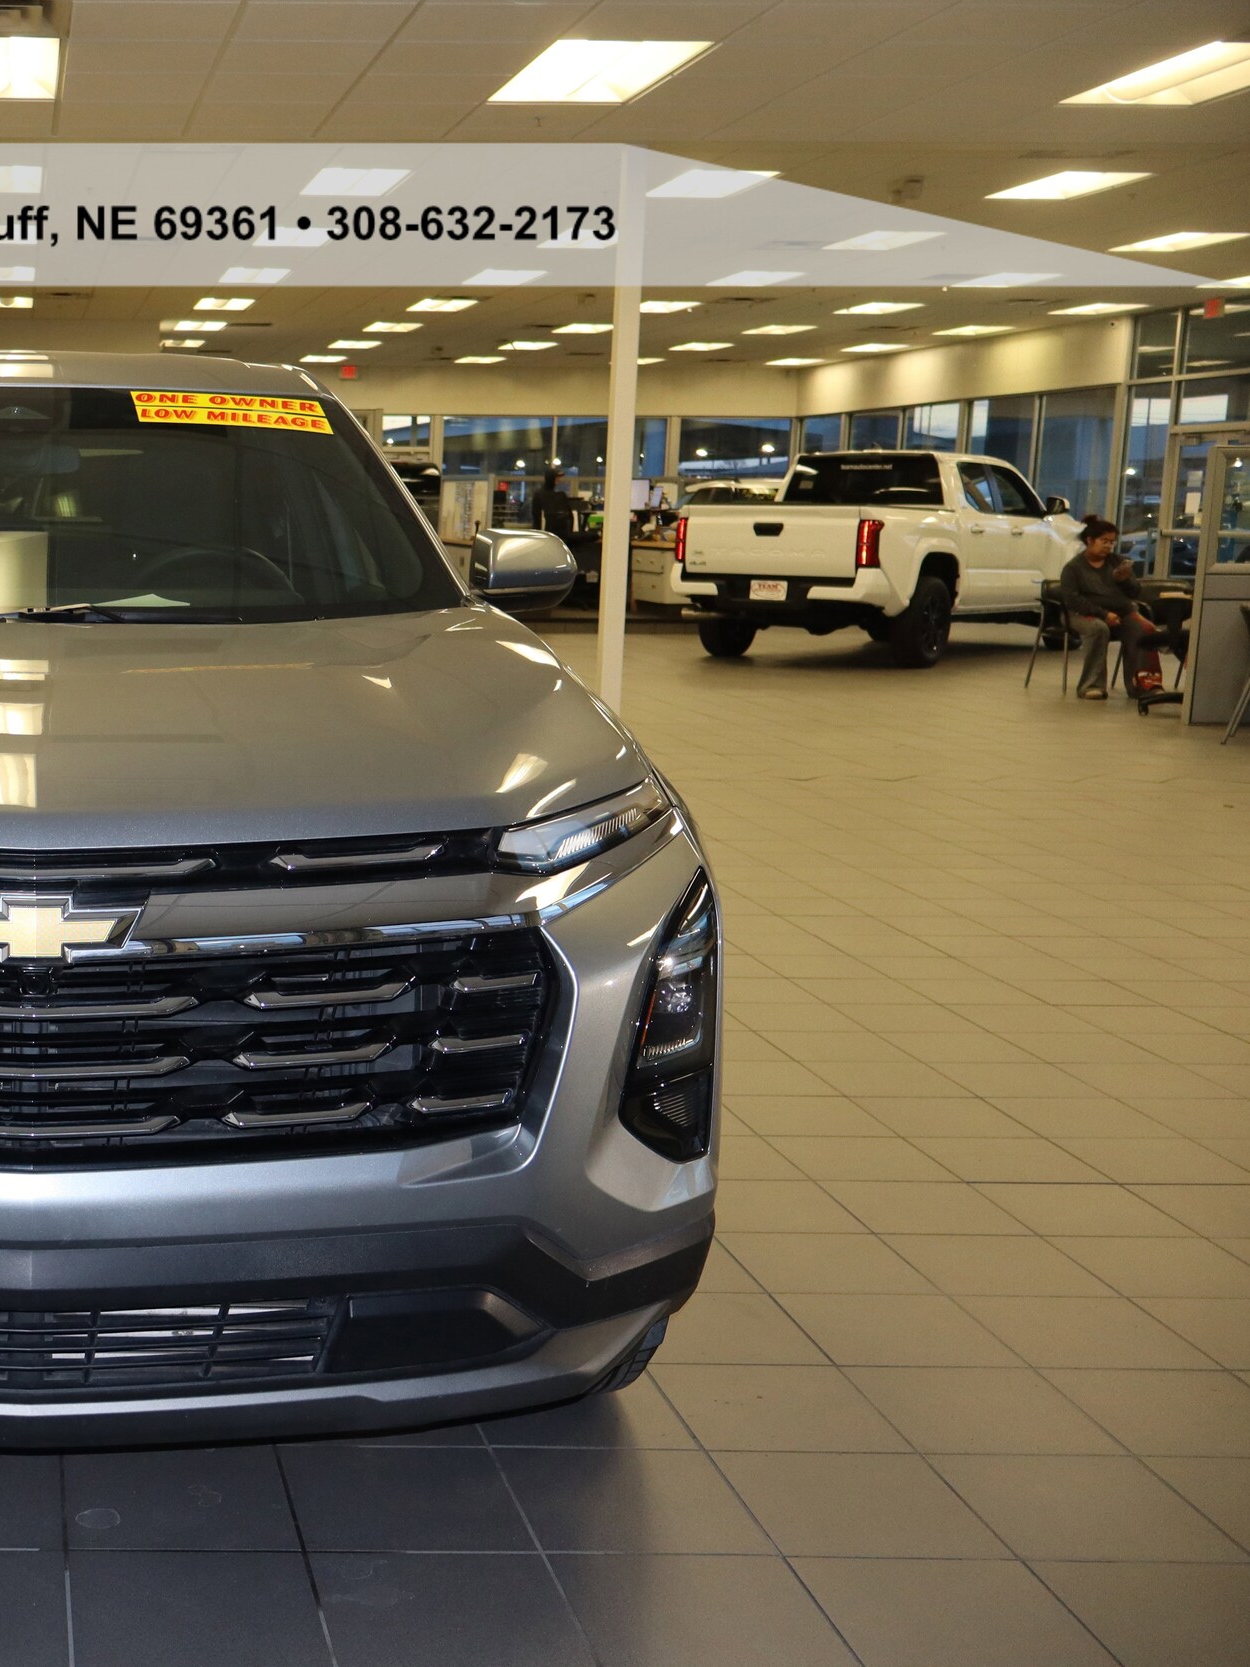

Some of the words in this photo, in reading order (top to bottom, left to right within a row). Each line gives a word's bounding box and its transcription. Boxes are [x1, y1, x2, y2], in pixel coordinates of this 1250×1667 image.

[135, 393, 198, 405] ONE
[209, 395, 318, 413] OWNER
[140, 408, 196, 420] LOW
[207, 410, 328, 430] MILEAGE
